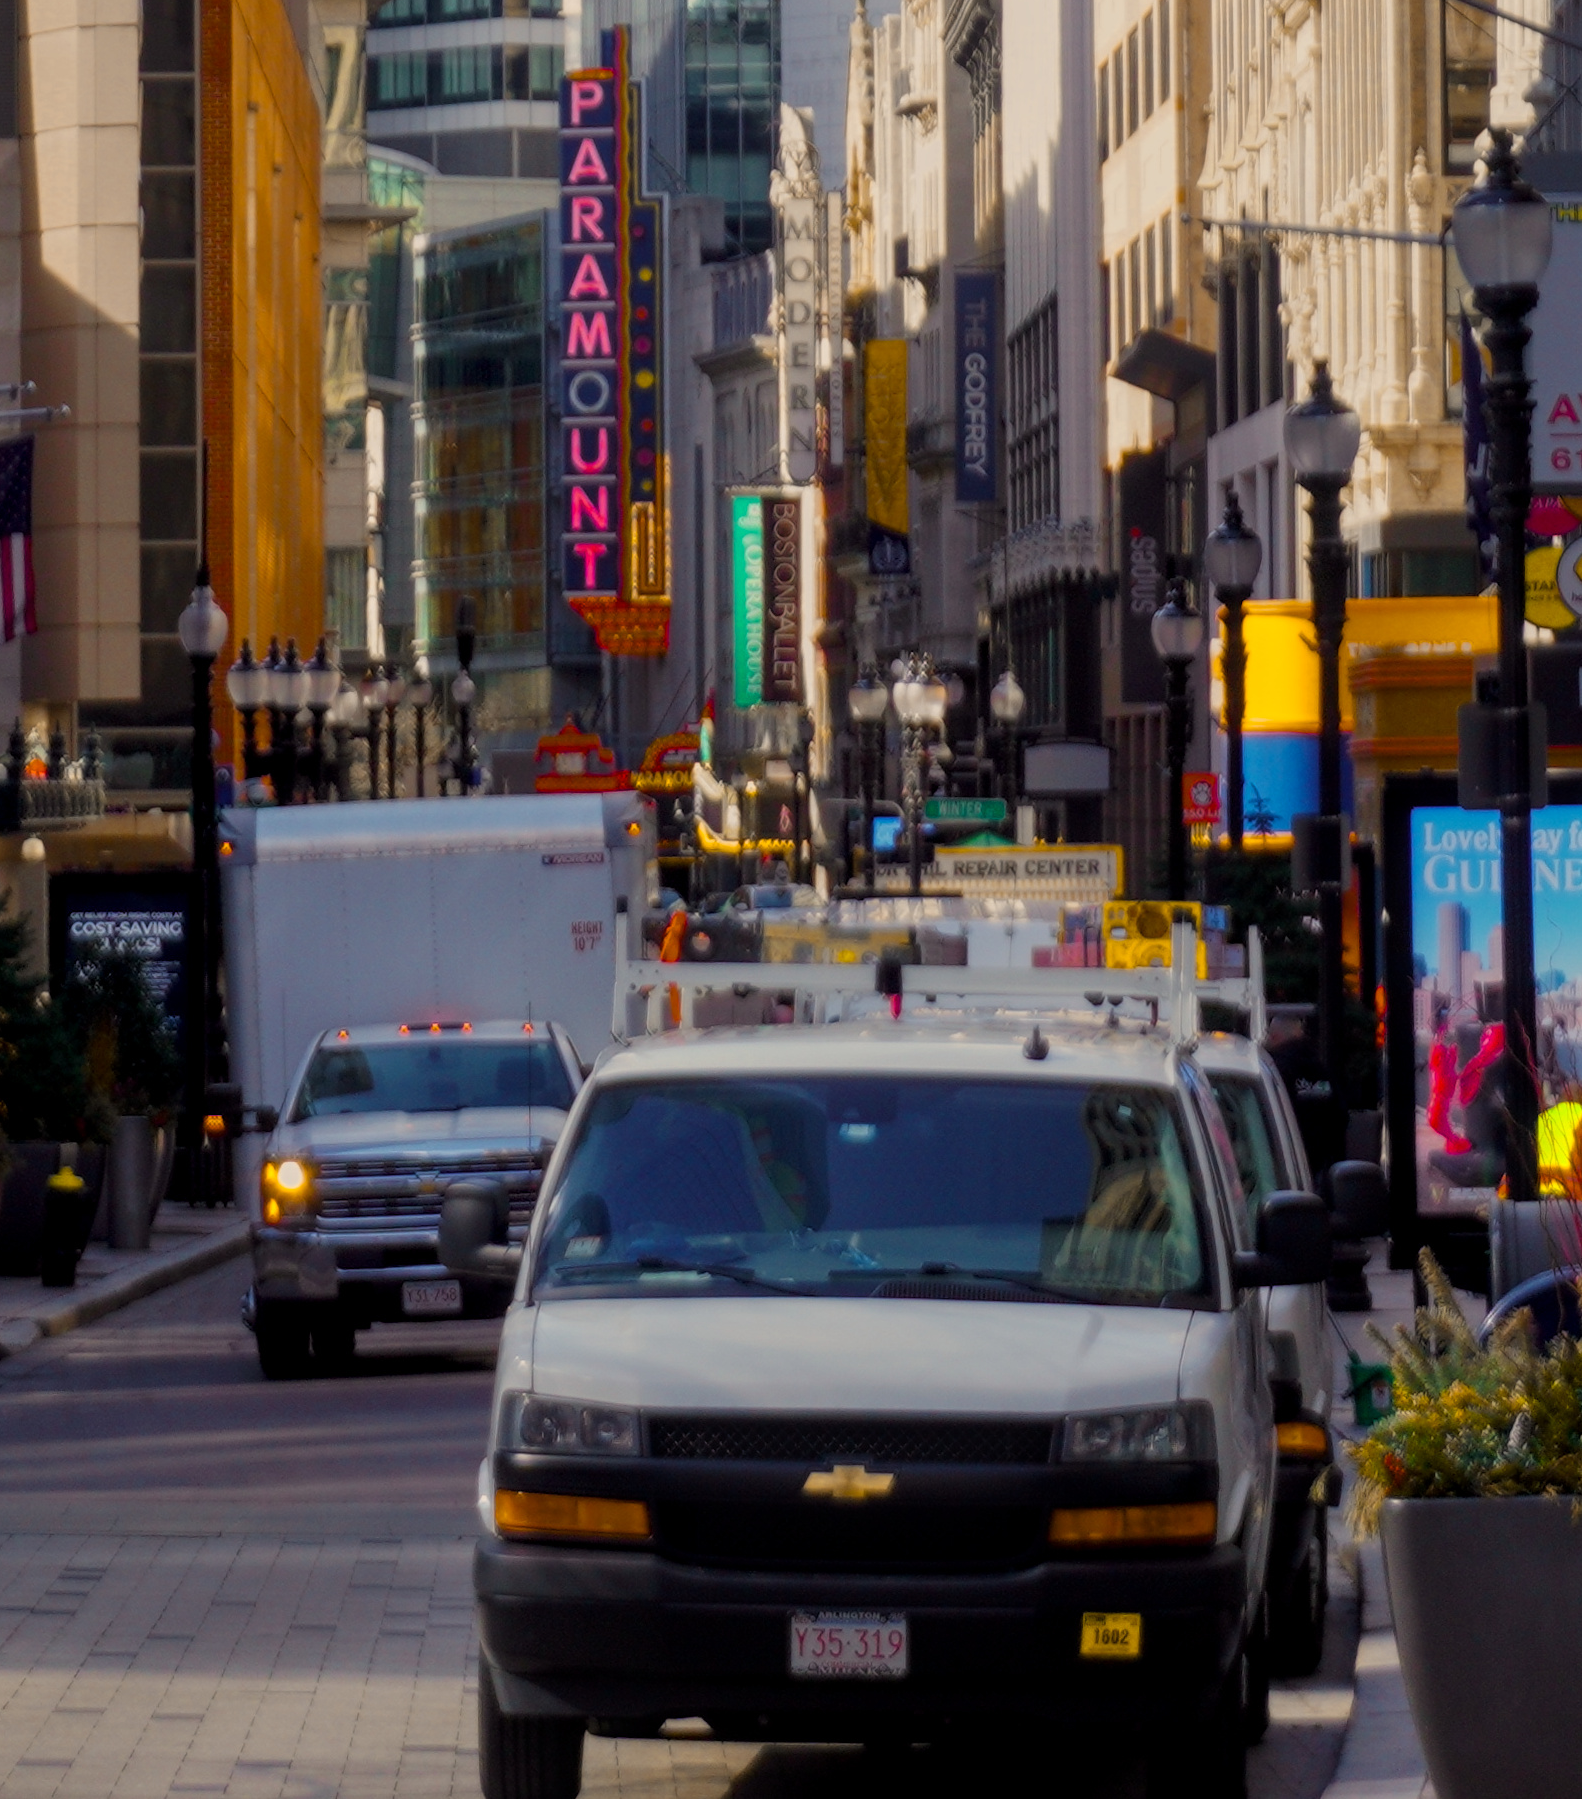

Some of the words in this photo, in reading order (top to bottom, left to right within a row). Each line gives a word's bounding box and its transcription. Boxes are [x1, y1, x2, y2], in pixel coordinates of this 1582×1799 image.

[565, 79, 613, 590] PARAMOUNT
[784, 214, 813, 452] MODERN
[965, 298, 986, 347] THE
[831, 356, 842, 438] SUFFOLK
[965, 352, 988, 477] GODFREY
[1129, 536, 1161, 613] snipes
[746, 623, 762, 695] HOUSE
[938, 801, 985, 818] WINTER
[1423, 820, 1501, 853] Lovel
[1532, 828, 1563, 855] ay
[954, 860, 1017, 877] REPAIR
[1024, 858, 1100, 876] CENTER
[71, 921, 183, 935] COST-SAVING
[571, 920, 604, 934] HEIGHT
[818, 1611, 880, 1620] ARLINGTON
[1095, 1628, 1129, 1645] 1602
